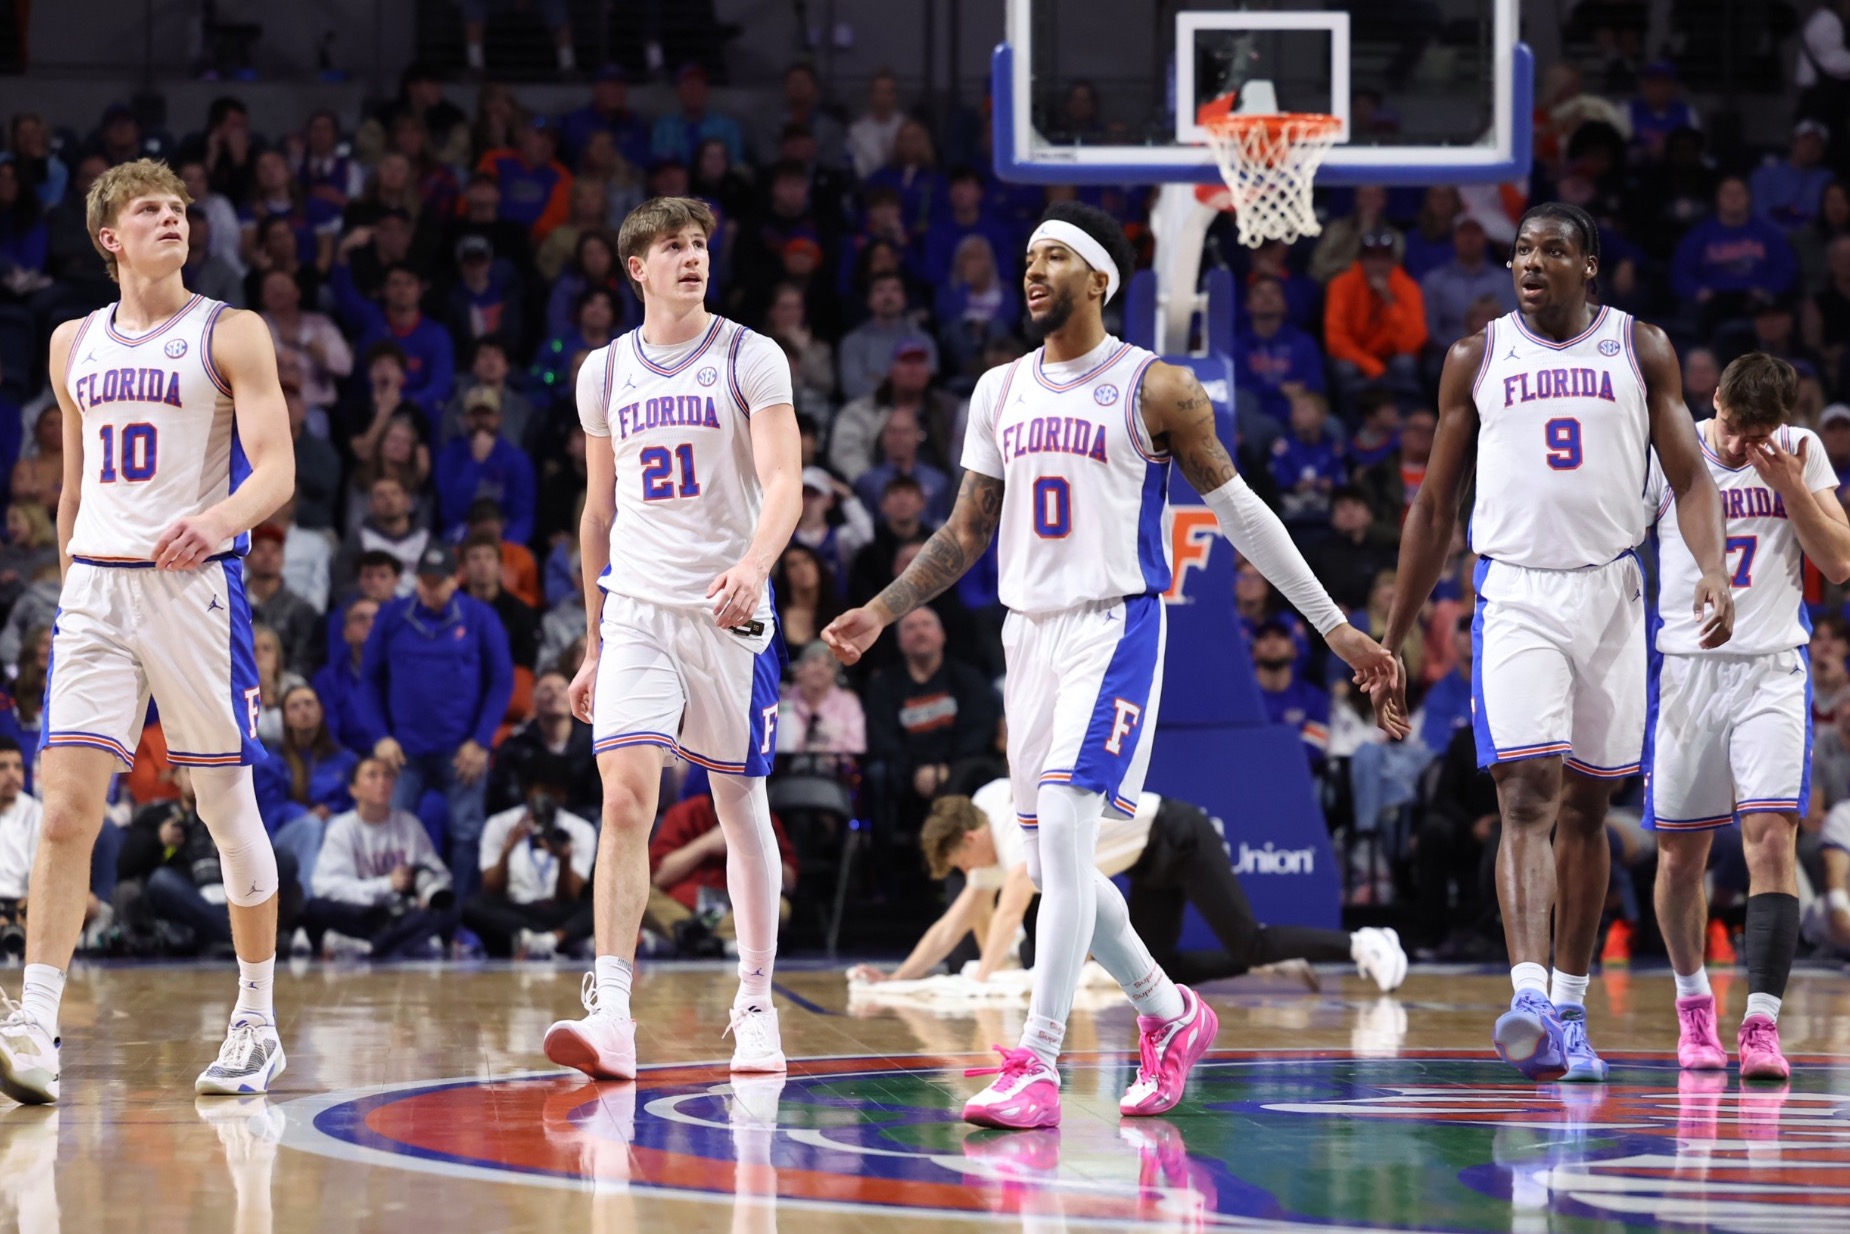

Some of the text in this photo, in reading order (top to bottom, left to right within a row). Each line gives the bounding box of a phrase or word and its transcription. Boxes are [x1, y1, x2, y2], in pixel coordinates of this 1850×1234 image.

[164, 339, 188, 359] SEC
[1597, 339, 1620, 357] SEC
[77, 368, 182, 412] FLORIDA
[697, 366, 717, 387] SEC
[1503, 367, 1616, 408] FLORIDA
[618, 395, 720, 440] FLORIDA
[1003, 417, 1107, 464] FLORIDA
[1545, 417, 1583, 470] 9
[100, 422, 157, 483] 10
[640, 443, 701, 501] 21
[1033, 476, 1072, 539] 0
[1164, 505, 1223, 604] F
[1726, 535, 1757, 588] 7
[243, 685, 260, 740] F
[761, 701, 779, 755] F
[1104, 697, 1141, 756] F
